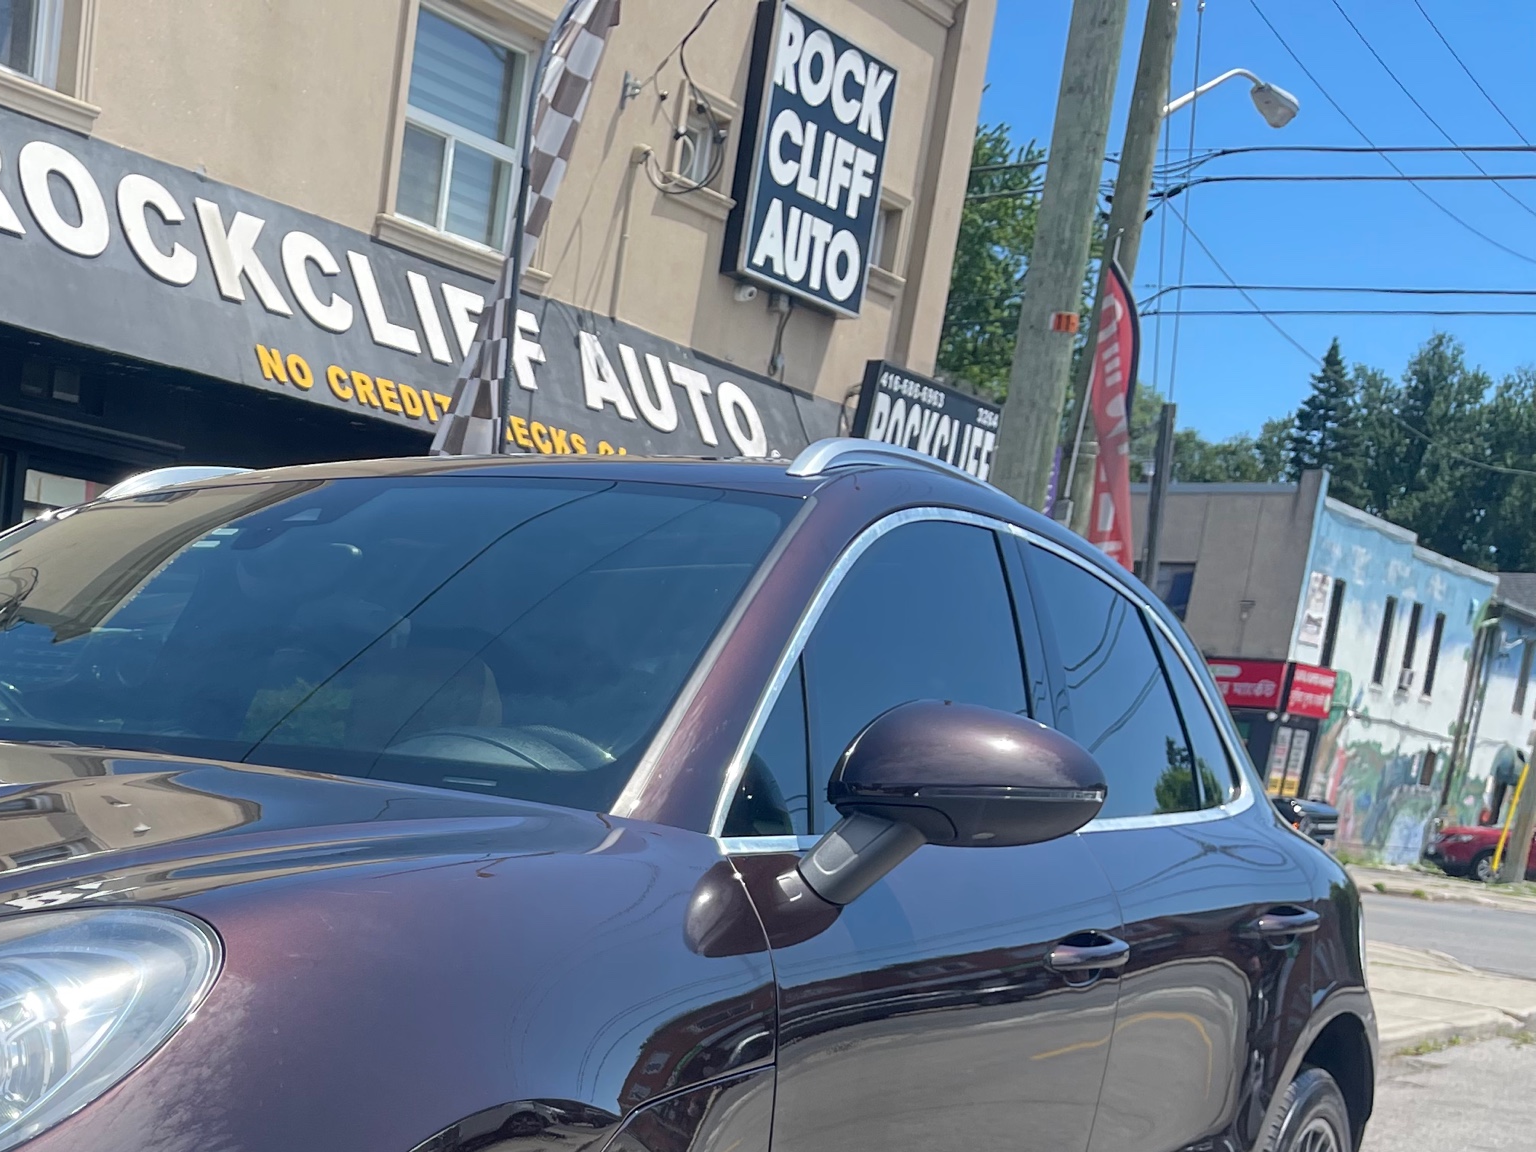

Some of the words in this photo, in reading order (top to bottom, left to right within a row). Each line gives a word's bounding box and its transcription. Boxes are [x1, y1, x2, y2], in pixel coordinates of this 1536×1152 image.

[773, 8, 895, 142] ROCK
[768, 108, 877, 219] CLIFF
[751, 197, 860, 302] AUTO
[255, 343, 314, 390] NO
[327, 364, 452, 422] CREDIT
[505, 415, 588, 456] ECKS
[578, 330, 768, 457] AUTO
